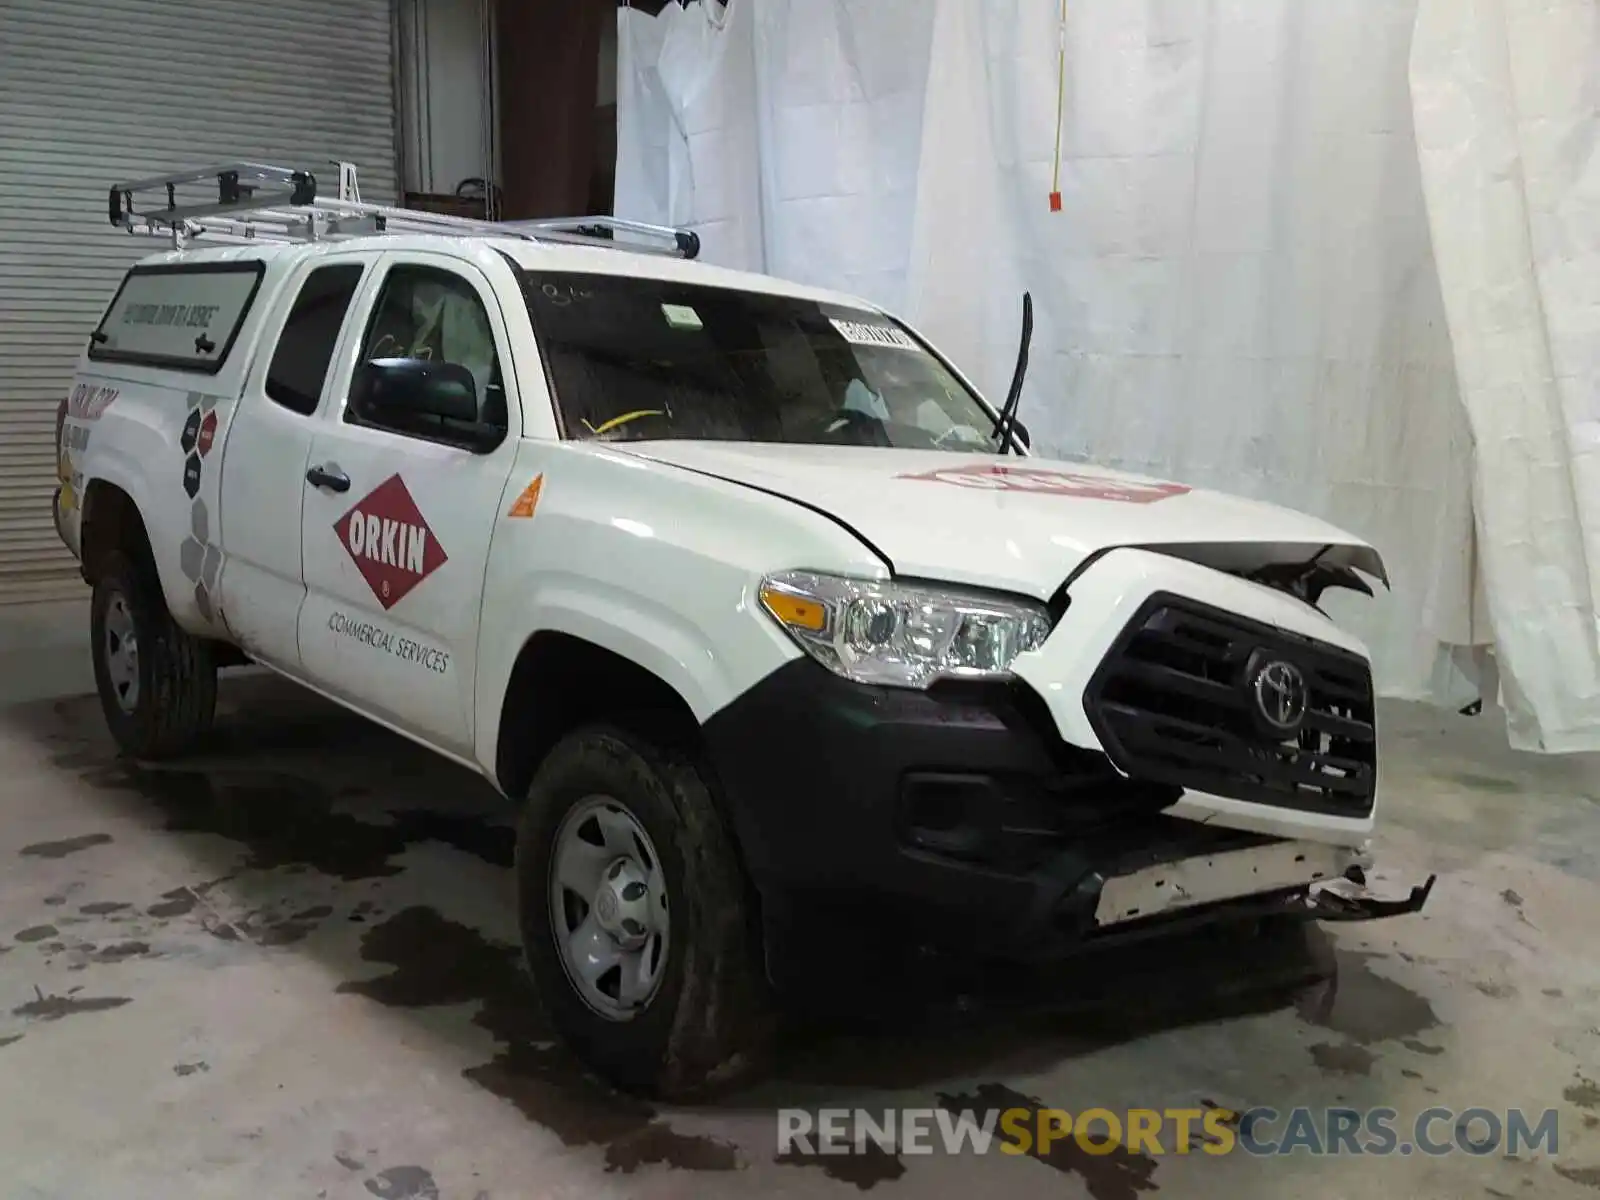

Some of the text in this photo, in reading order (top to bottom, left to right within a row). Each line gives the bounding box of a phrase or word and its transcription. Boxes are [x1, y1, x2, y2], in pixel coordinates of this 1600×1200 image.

[350, 510, 426, 575] ORKIN
[328, 611, 449, 674] COMMERCIAL SERVICES
